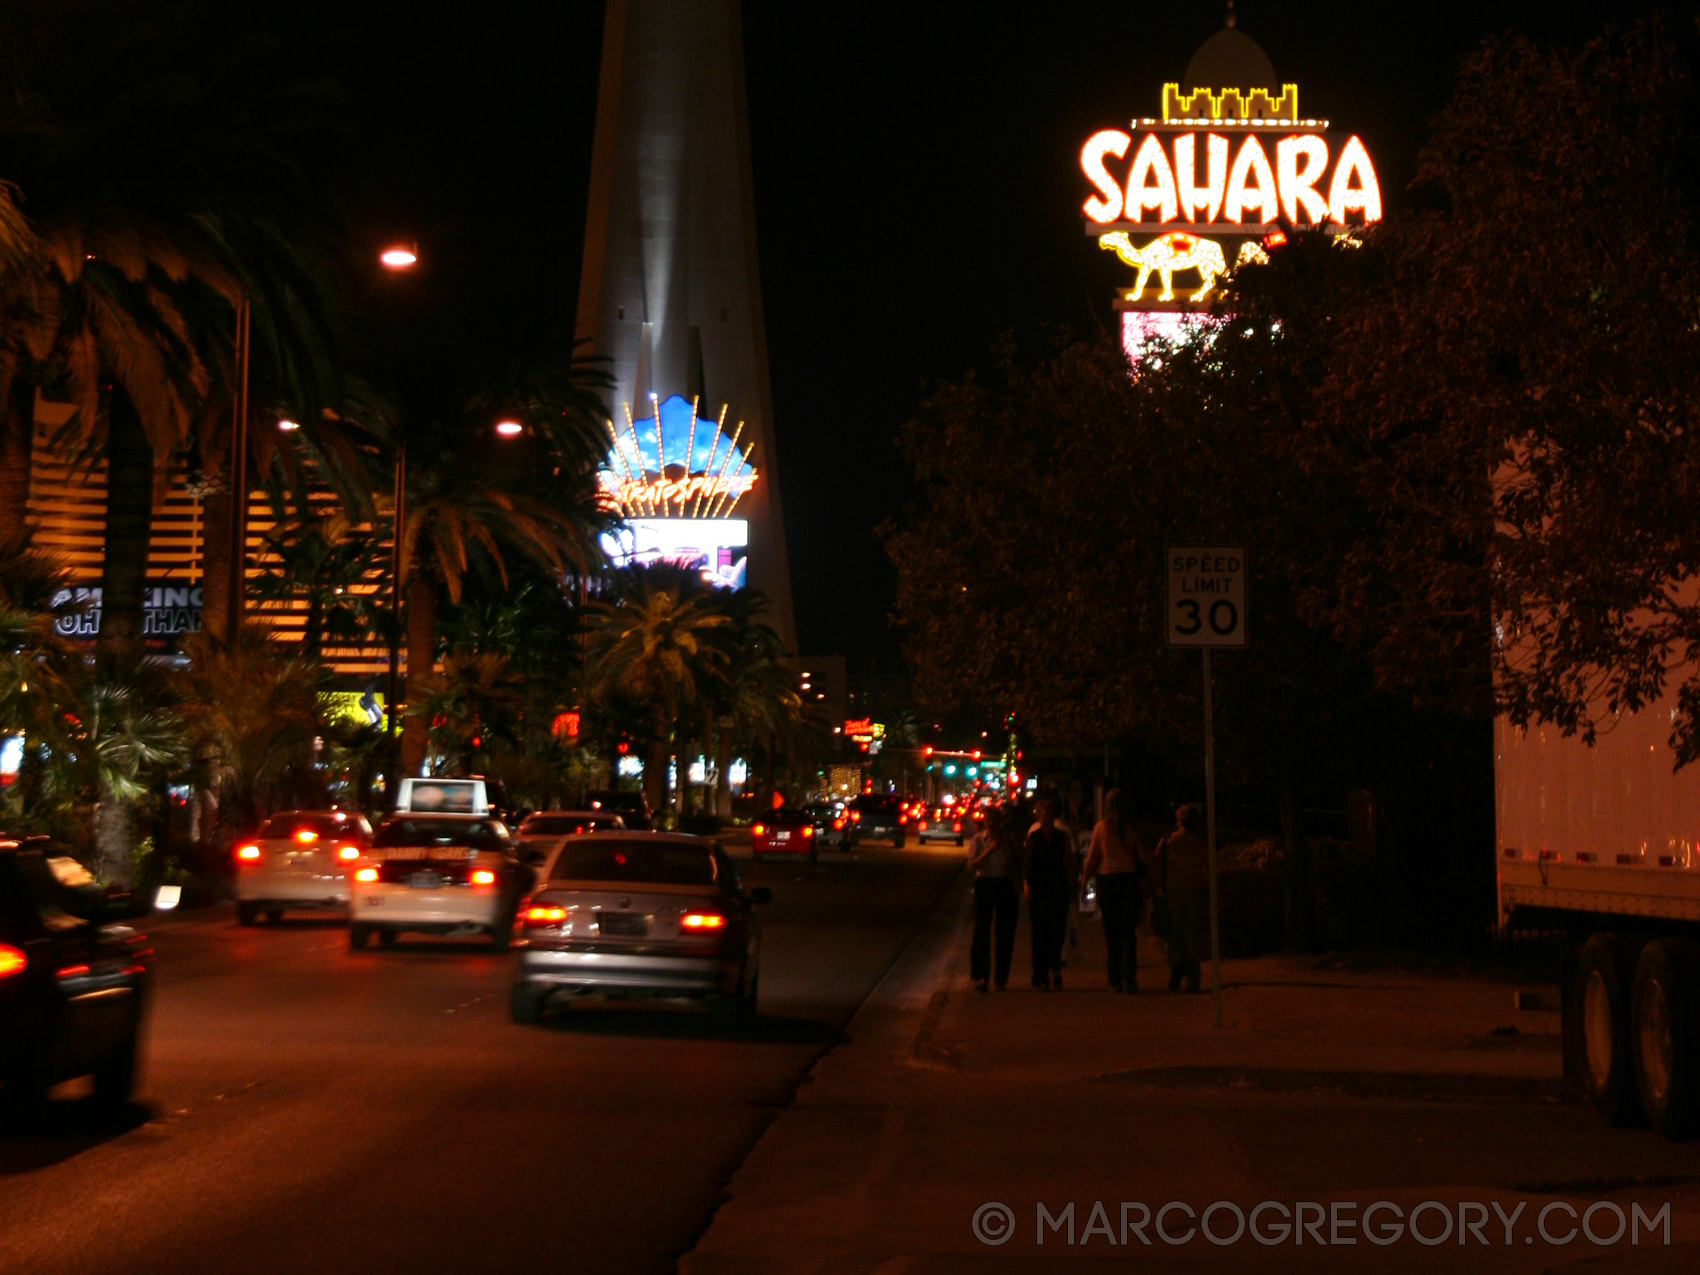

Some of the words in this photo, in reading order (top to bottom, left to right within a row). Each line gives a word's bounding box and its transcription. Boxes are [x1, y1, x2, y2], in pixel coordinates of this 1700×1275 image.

[1080, 128, 1382, 225] SAHARA
[1173, 557, 1240, 572] SPEED
[1182, 578, 1232, 593] LIMIT
[1175, 599, 1238, 634] 30
